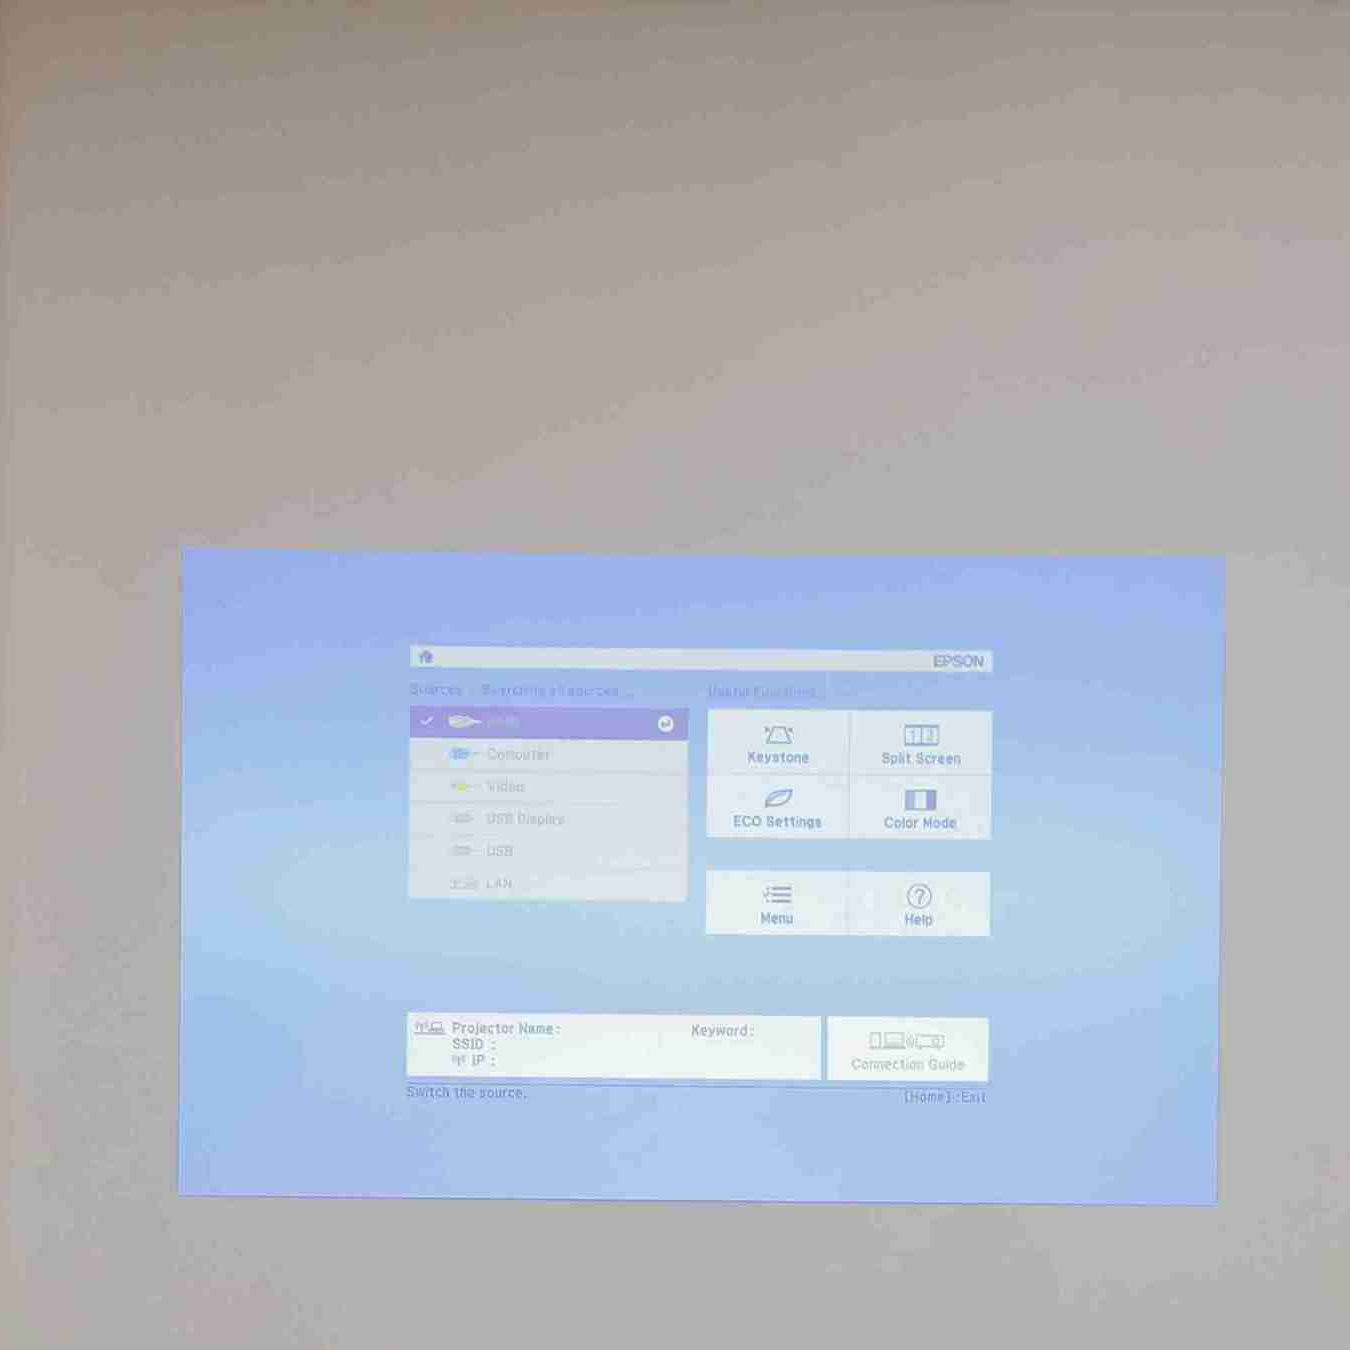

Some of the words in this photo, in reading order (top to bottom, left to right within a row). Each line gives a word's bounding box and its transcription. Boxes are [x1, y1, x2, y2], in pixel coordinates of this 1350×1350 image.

[933, 654, 985, 668] EPSON
[747, 751, 810, 767] Keystone
[881, 751, 911, 767] Split
[915, 751, 962, 765] Screen
[733, 815, 763, 828] ECO
[766, 815, 822, 831] Settings
[883, 816, 918, 829] Color
[922, 816, 957, 829] Mode
[760, 911, 794, 925] Menu
[904, 911, 934, 928] Help
[451, 1022, 515, 1037] Projector
[850, 1056, 925, 1071] Connection
[928, 1056, 966, 1071] Guide
[407, 1085, 450, 1099] Switch
[454, 1085, 476, 1099] the
